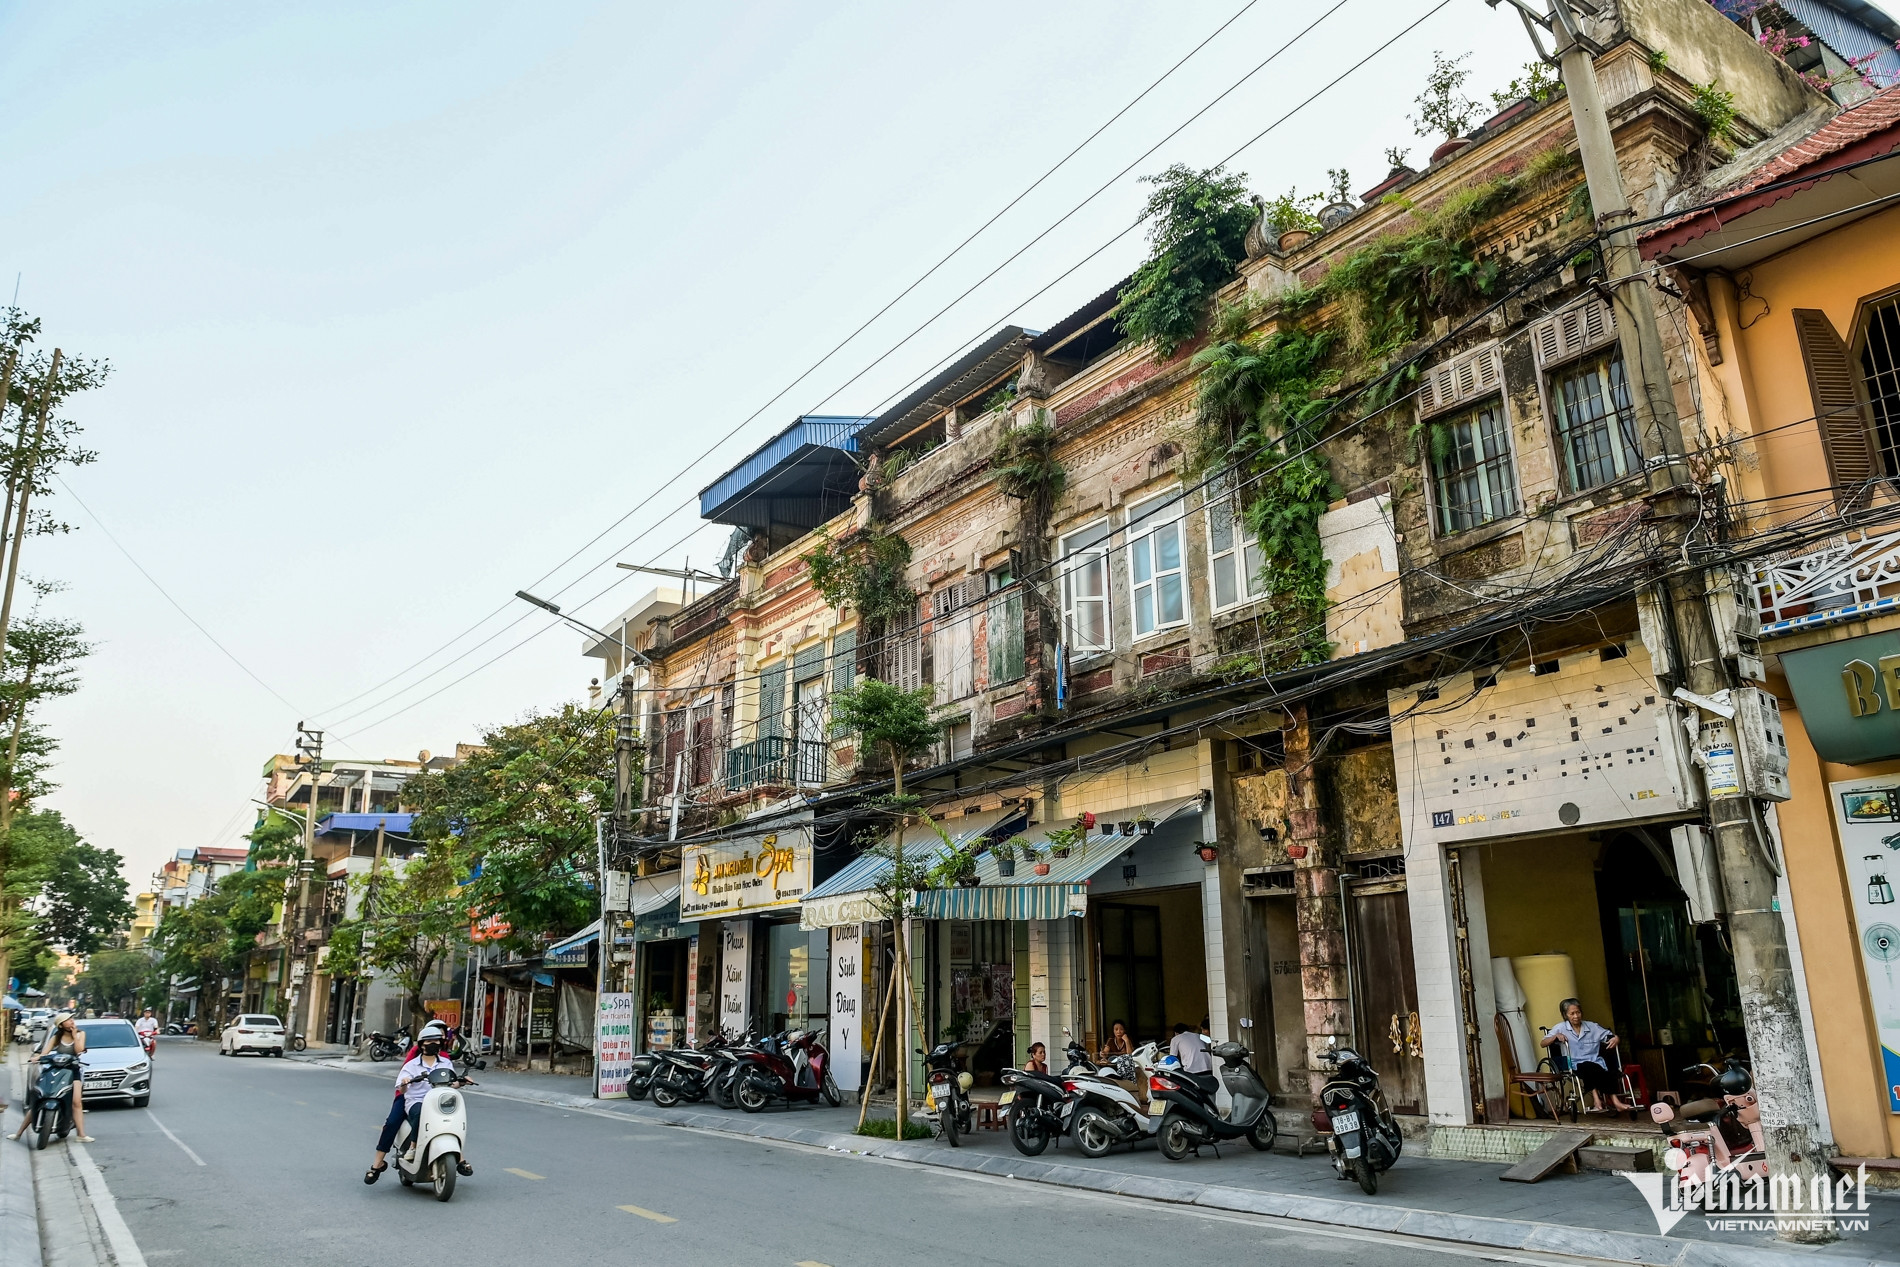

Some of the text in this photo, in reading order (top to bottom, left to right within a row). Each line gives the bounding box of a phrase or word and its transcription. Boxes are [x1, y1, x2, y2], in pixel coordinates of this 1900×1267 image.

[1434, 812, 1451, 826] 147
[726, 932, 744, 951] Phun
[726, 964, 742, 983] Xăm
[838, 956, 856, 978] Sinh
[614, 996, 630, 1010] SPA
[724, 994, 742, 1014] Thẩm
[835, 991, 856, 1018] Đông
[842, 1028, 849, 1050] Y
